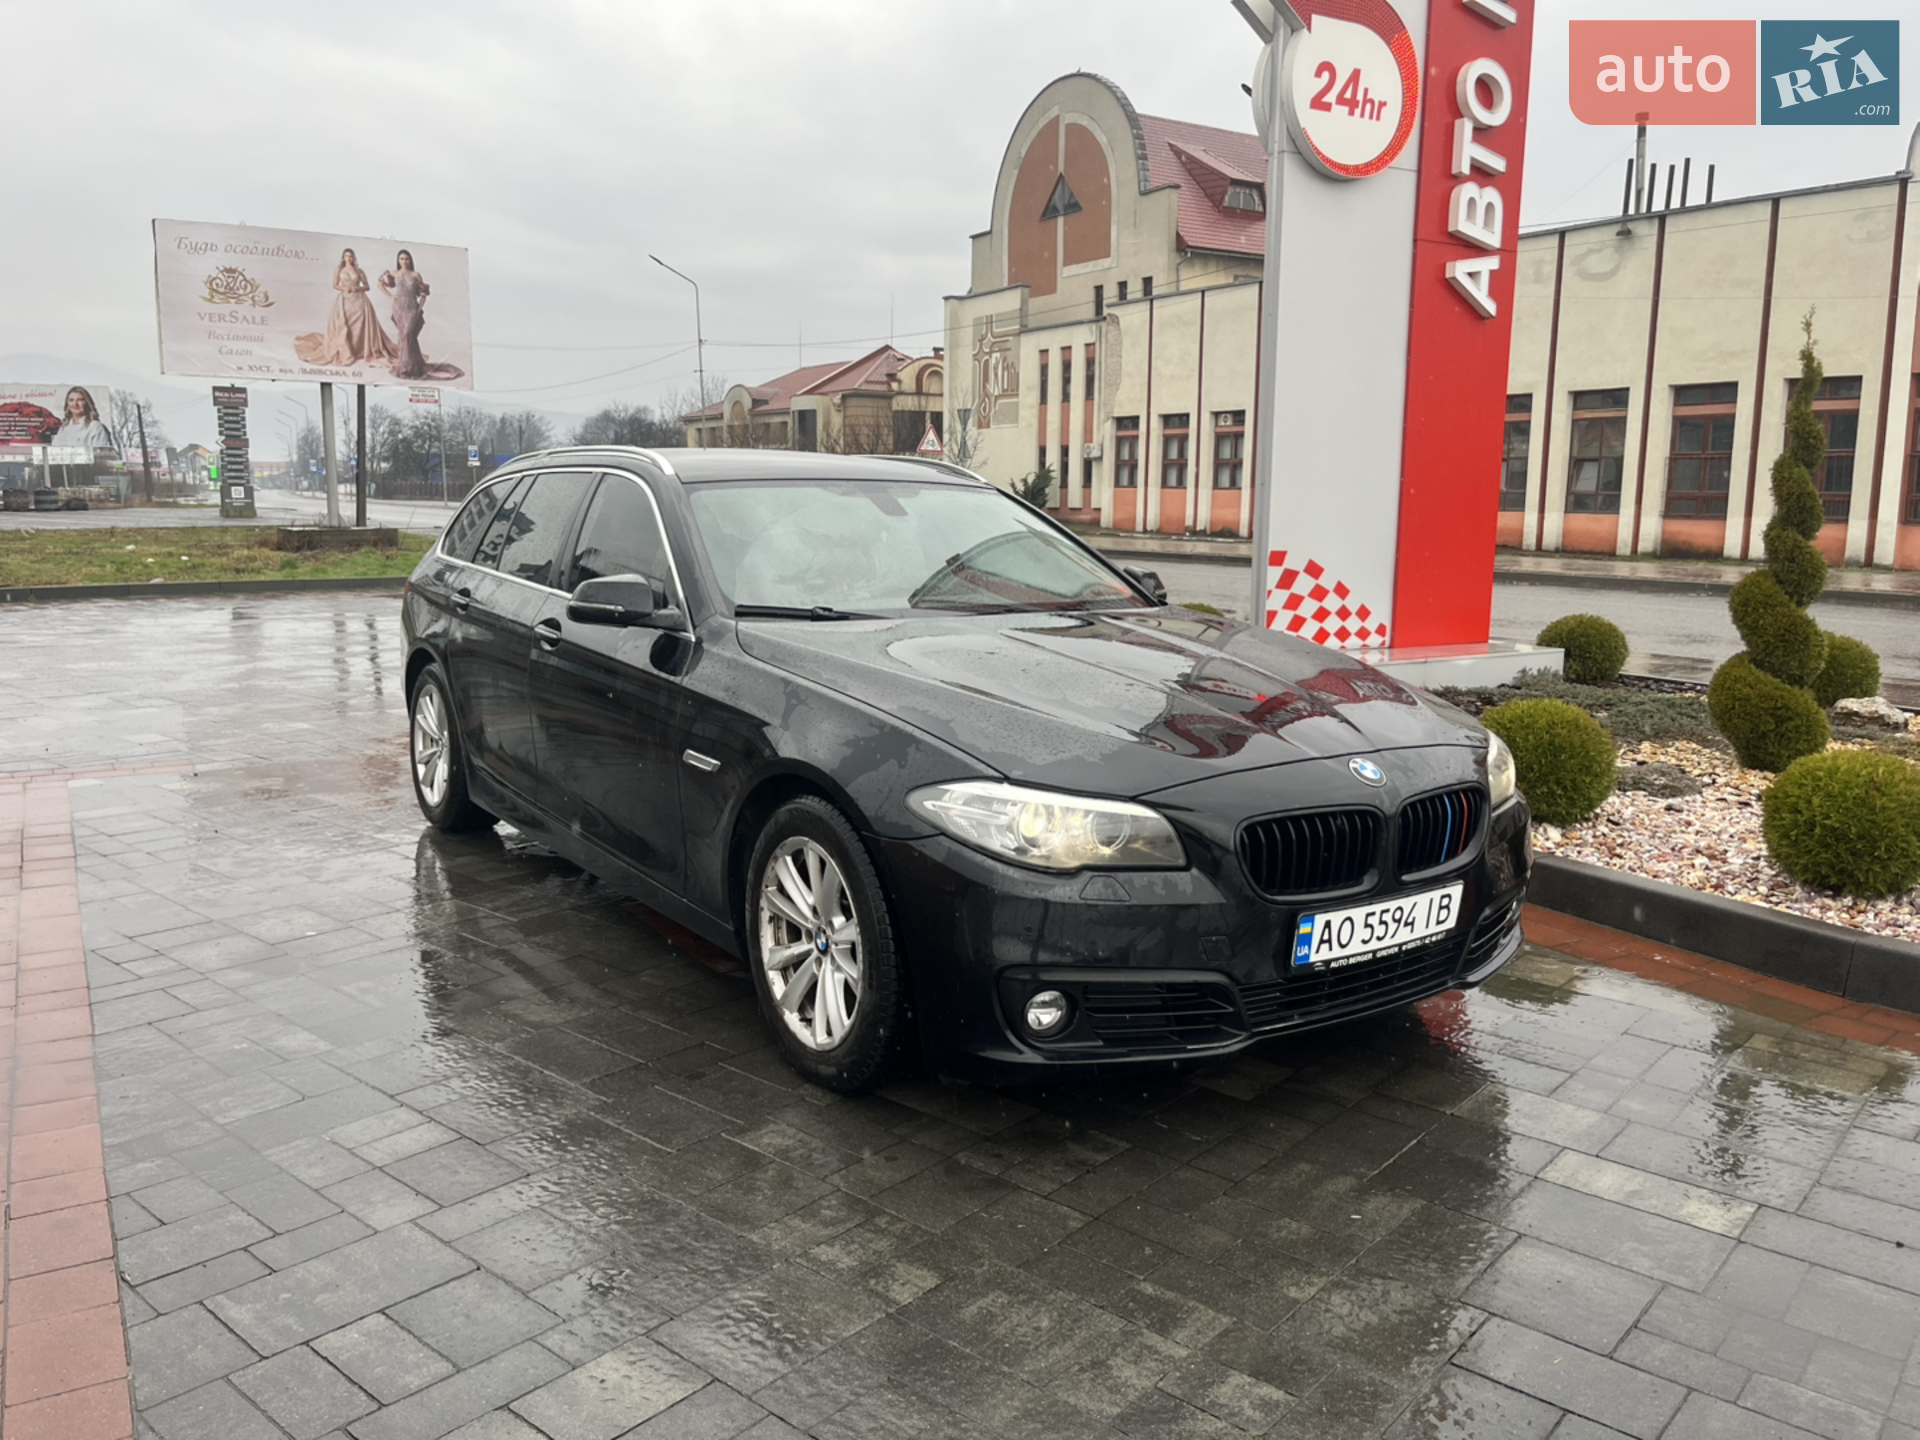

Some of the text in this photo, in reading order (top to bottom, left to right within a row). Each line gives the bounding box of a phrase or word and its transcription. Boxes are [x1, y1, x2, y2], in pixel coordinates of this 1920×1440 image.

[1308, 60, 1388, 122] 24hr
[174, 236, 320, 261] Будь особливою...
[205, 329, 265, 343] Весільний
[218, 345, 254, 357] Салон
[351, 370, 363, 379] 60
[1314, 915, 1356, 955] AO
[1360, 901, 1418, 946] 5594
[1424, 893, 1453, 930] IB
[1296, 944, 1310, 957] UA
[1329, 957, 1348, 969] AUTO
[1348, 952, 1374, 966] BERGER
